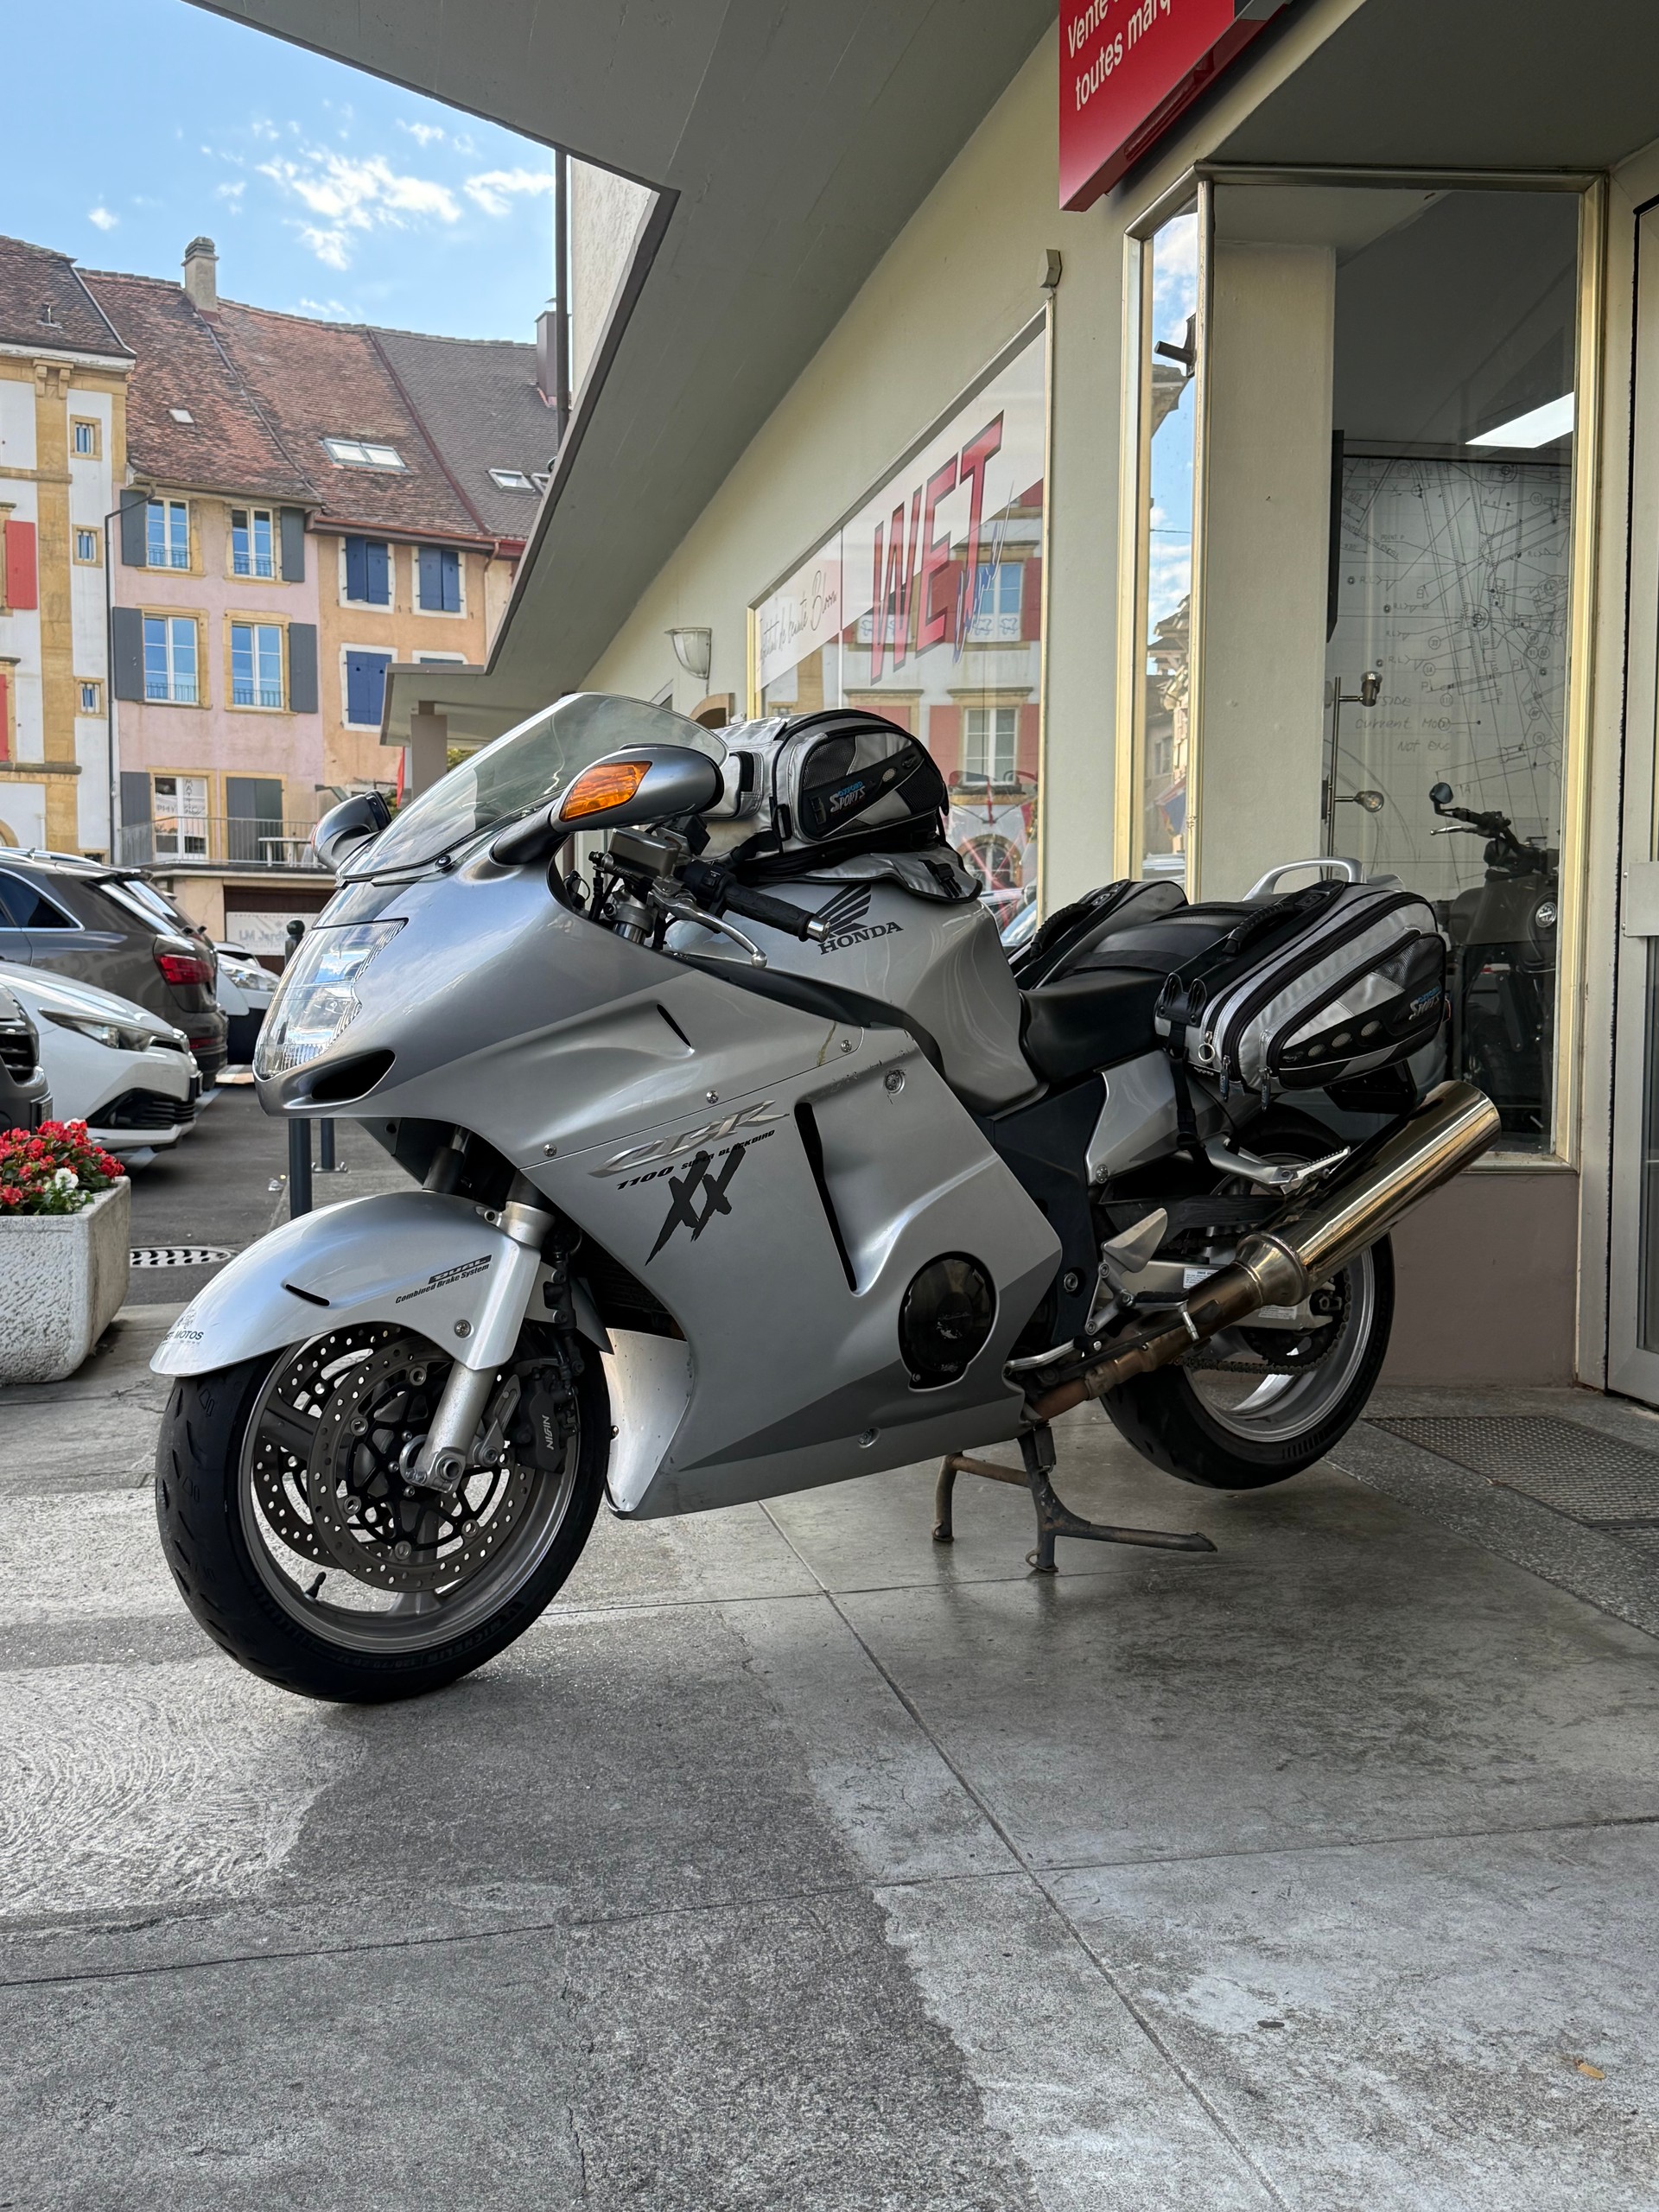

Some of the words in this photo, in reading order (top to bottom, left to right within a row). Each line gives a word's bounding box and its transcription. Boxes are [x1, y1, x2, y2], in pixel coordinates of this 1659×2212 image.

[1068, 0, 1108, 59] Vente
[1075, 32, 1122, 111] toutes
[870, 409, 1005, 687] WET
[830, 785, 866, 813] SPORTS
[837, 781, 863, 797] OXFORD
[817, 921, 904, 956] HONDA
[588, 1100, 790, 1179] CBR
[617, 1166, 675, 1191] 1100
[718, 1129, 776, 1158] BLACKBIRD
[645, 1142, 747, 1267] XX
[395, 1281, 436, 1304] Combined
[436, 1275, 461, 1288] Brake
[461, 1263, 490, 1280] System
[174, 1330, 205, 1341] MOTOS
[427, 1618, 502, 1664] MICHELIN
